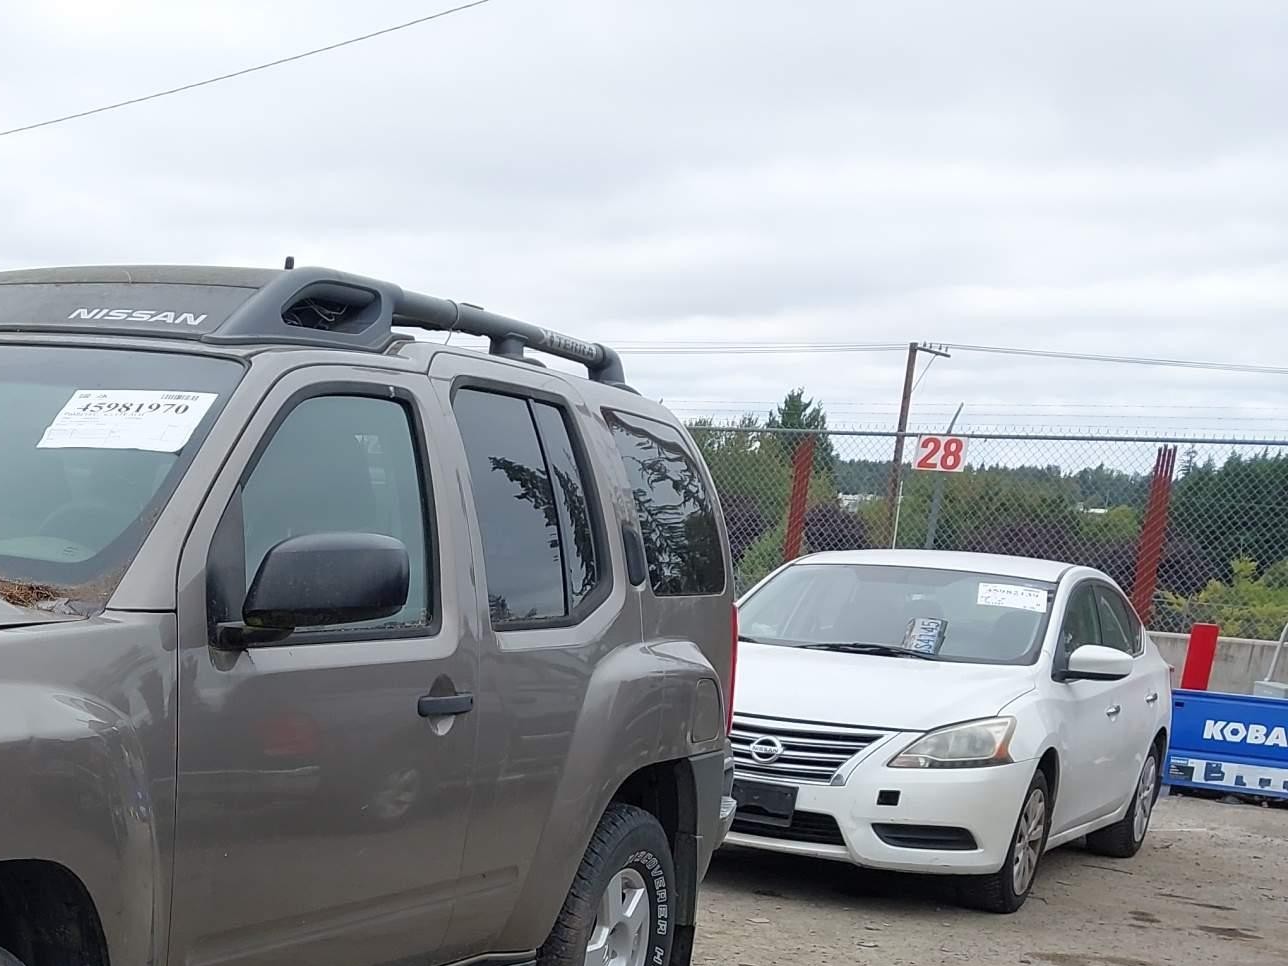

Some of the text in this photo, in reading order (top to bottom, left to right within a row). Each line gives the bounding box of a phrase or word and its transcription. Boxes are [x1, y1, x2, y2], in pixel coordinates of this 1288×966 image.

[68, 308, 208, 325] NISSAN
[77, 402, 190, 415] 45981970
[917, 437, 963, 470] 28
